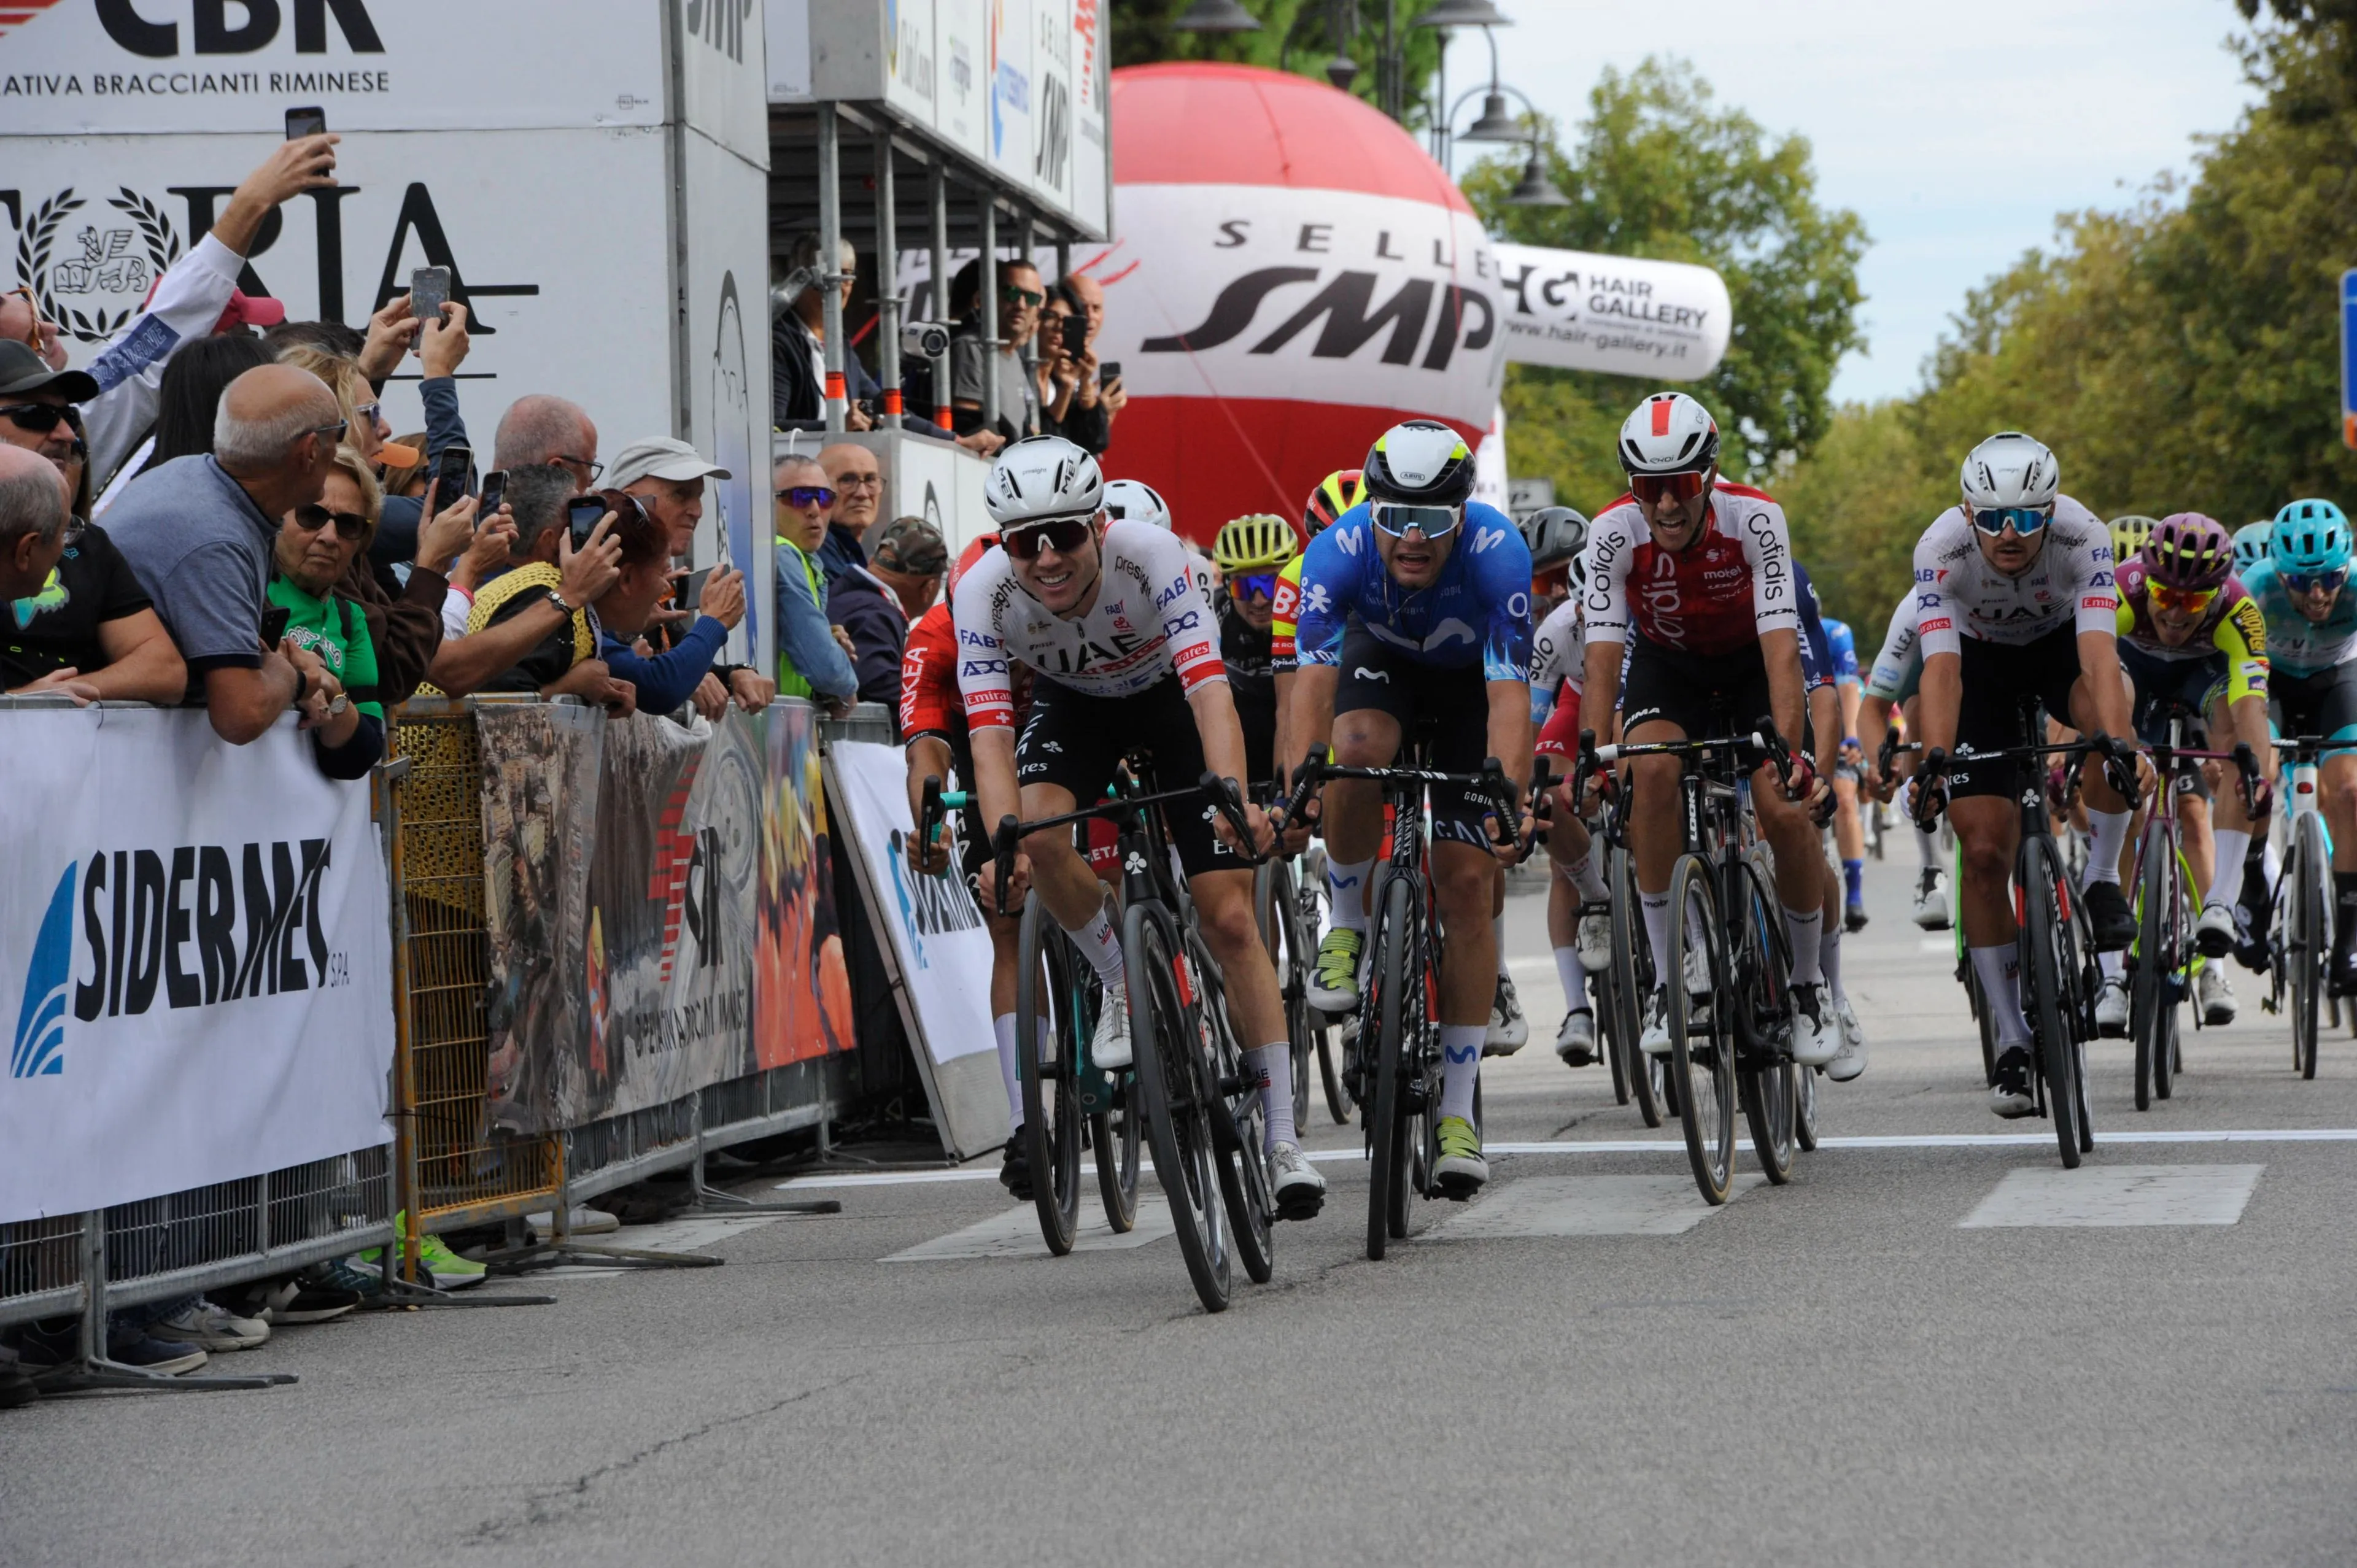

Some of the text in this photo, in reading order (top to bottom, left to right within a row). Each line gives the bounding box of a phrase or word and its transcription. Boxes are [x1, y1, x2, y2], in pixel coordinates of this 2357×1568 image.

[0, 71, 390, 96] ATIVA BRACCIANTI RIMINESE
[1214, 219, 1493, 279] SELLE
[1590, 276, 1653, 298] HAIR
[1140, 266, 1495, 372] SMP
[1589, 294, 1708, 329] GALLERY
[1588, 531, 1626, 612] Cofidis
[1747, 512, 1787, 601] Cofidis
[1914, 568, 1934, 582] AB
[2084, 598, 2117, 611] Emira
[1919, 619, 1951, 635] irates
[1174, 644, 1209, 668] irates
[899, 646, 929, 732] ARKEA
[1365, 767, 1449, 780] CAON
[1688, 788, 1698, 841] LOOK
